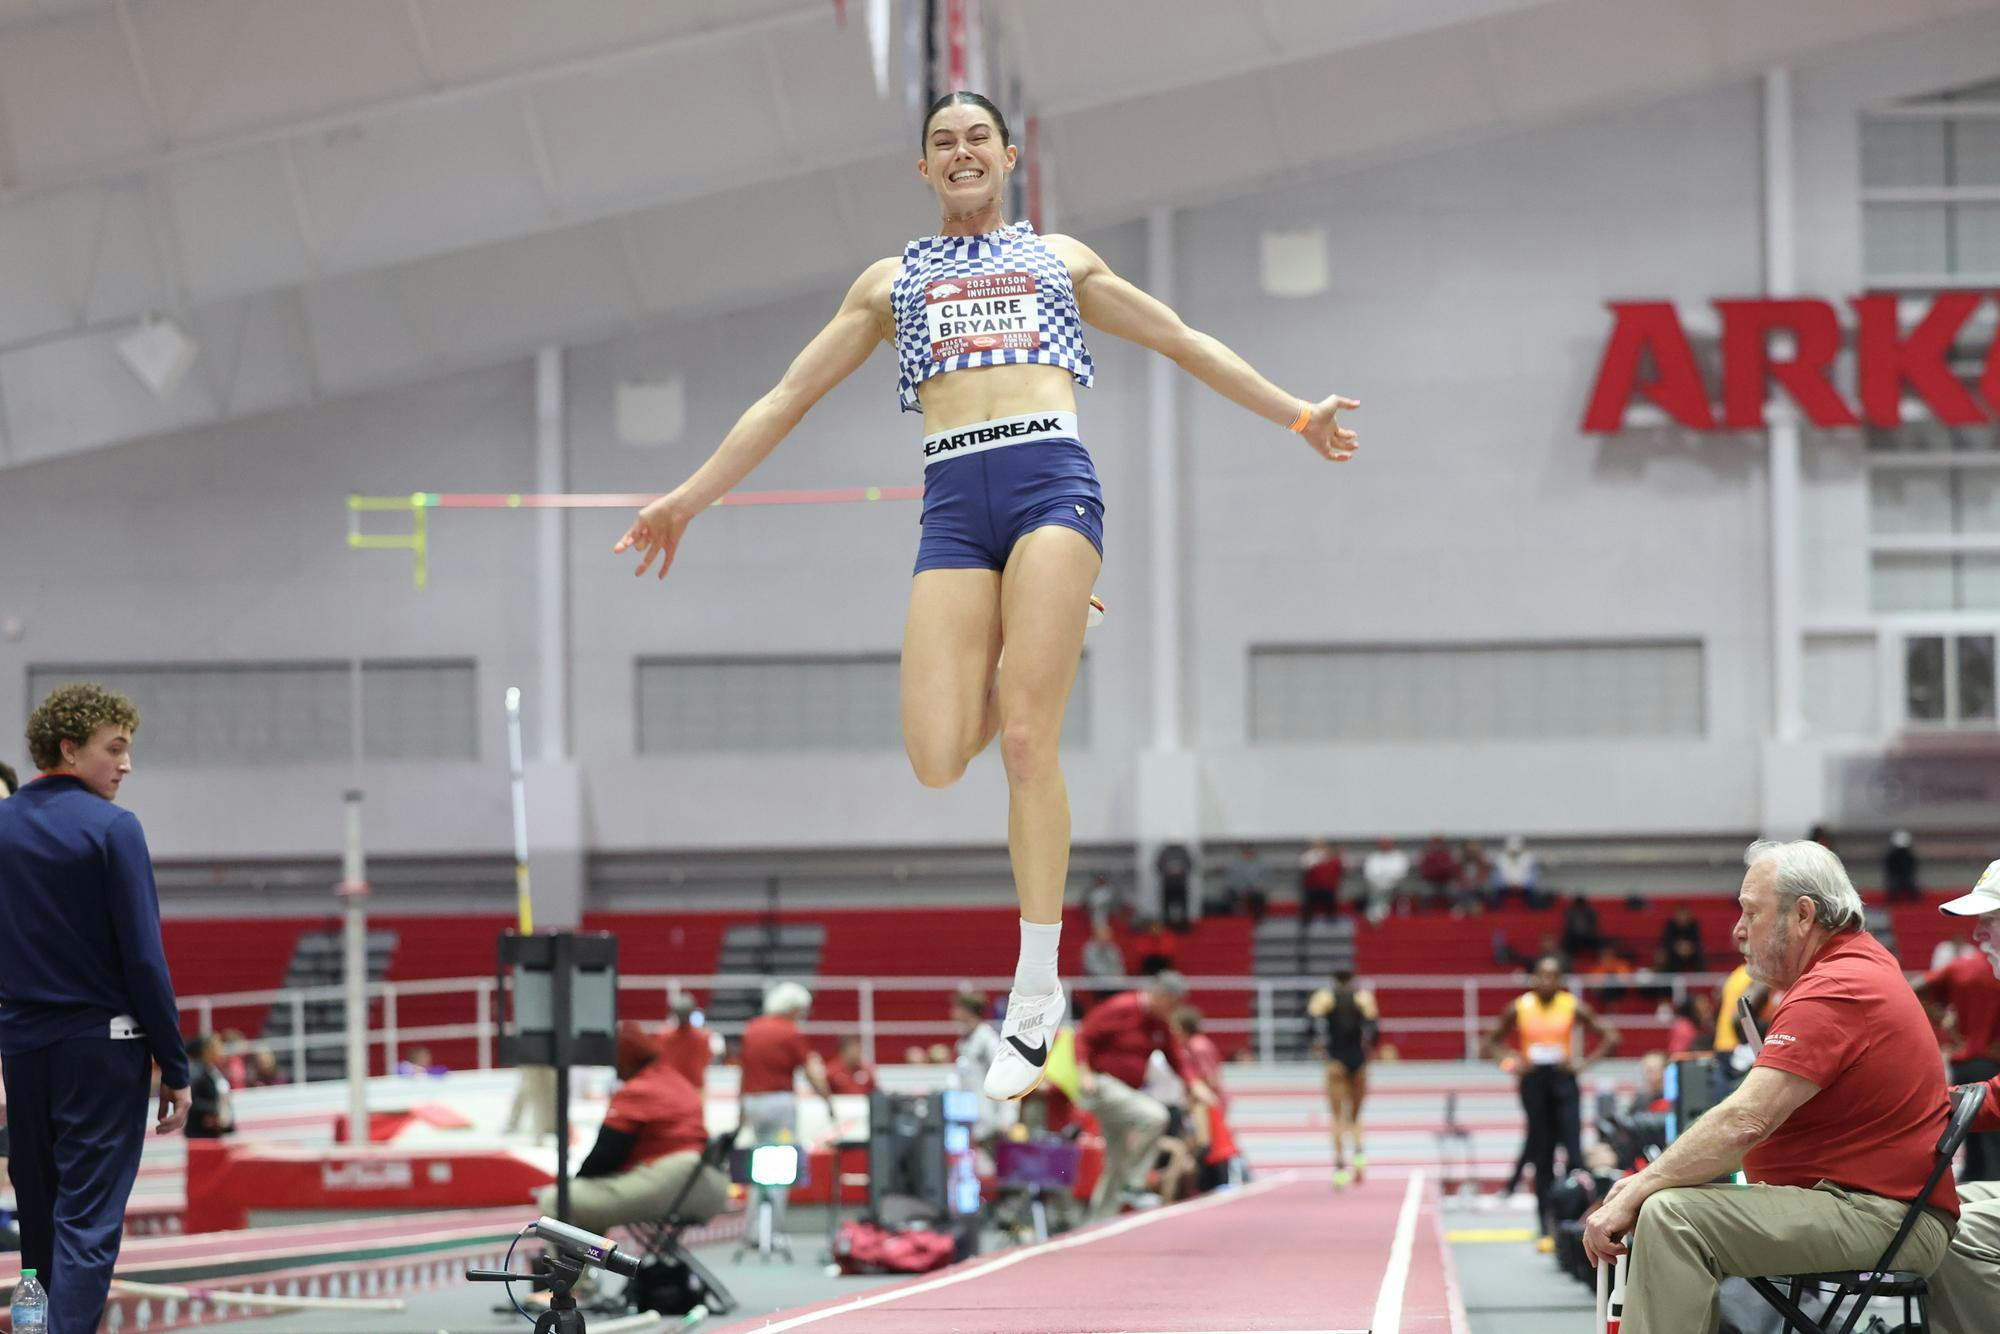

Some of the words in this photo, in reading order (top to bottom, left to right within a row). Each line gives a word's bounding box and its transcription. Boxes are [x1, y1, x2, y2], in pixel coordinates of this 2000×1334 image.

[966, 279, 991, 289] 2025
[996, 276, 1027, 286] TYSON
[967, 285, 1028, 298] INVITATIONAL
[941, 299, 1021, 319] CLAIRE
[939, 316, 1027, 338] BRYANT
[942, 347, 965, 358] WORLD
[1579, 290, 2000, 435] ARK
[1018, 1013, 1045, 1032] NIKE
